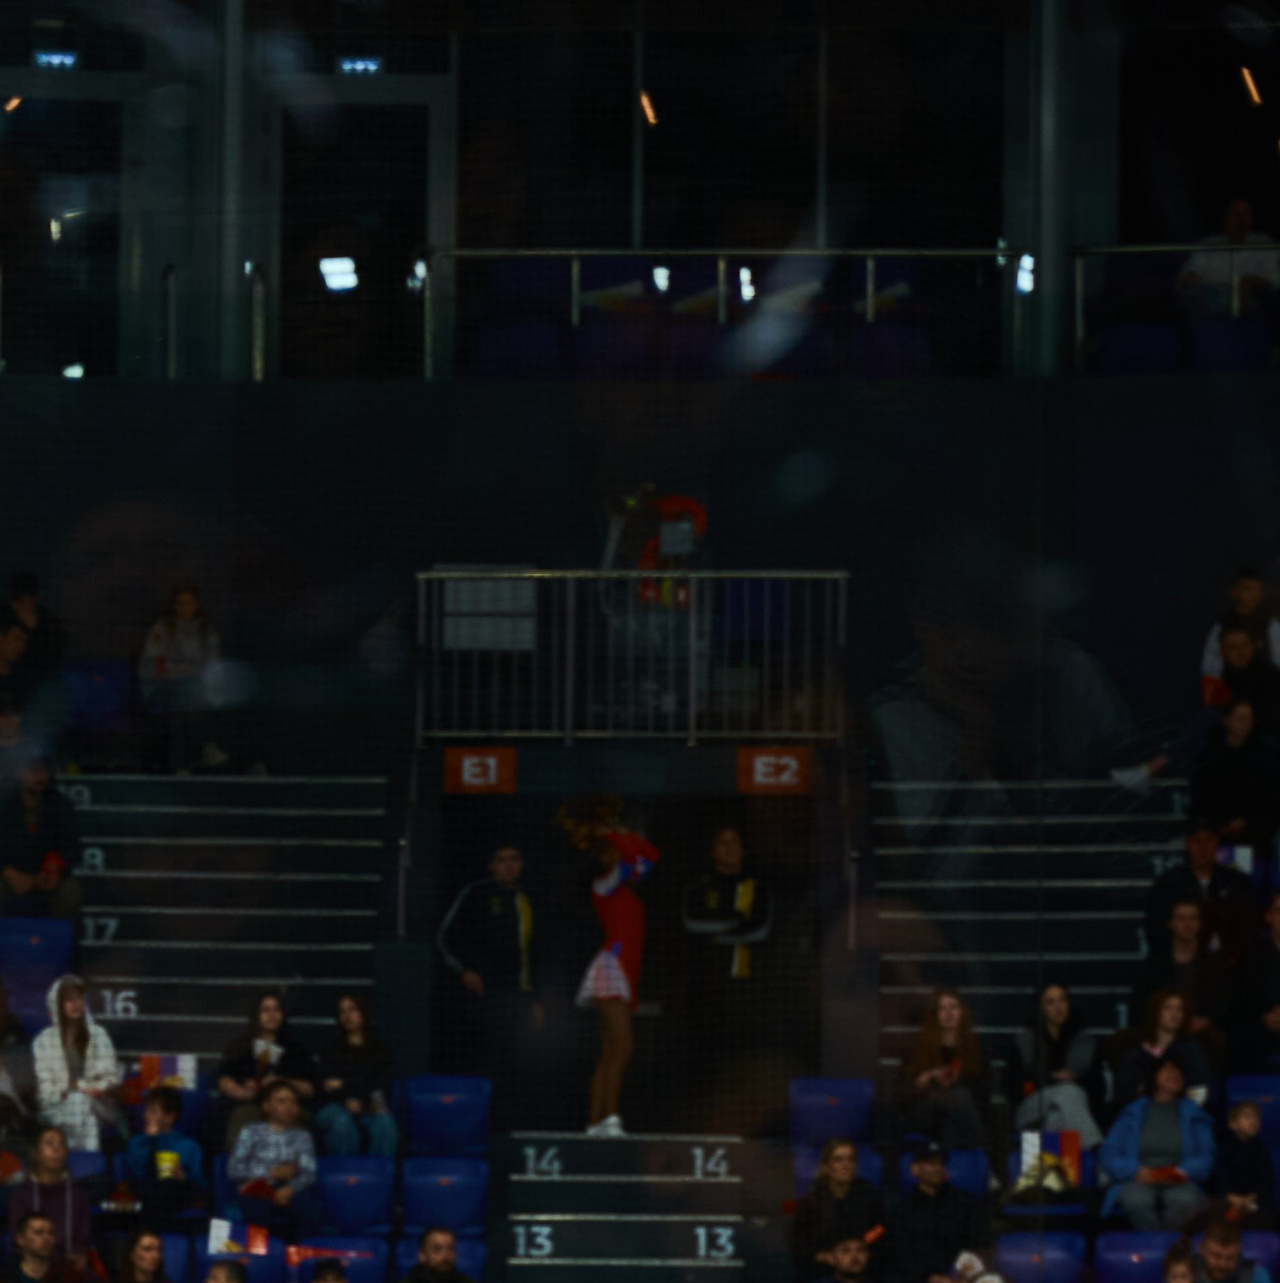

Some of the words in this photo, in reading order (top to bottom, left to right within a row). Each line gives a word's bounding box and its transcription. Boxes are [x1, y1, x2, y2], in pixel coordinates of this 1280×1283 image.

[461, 755, 499, 786] E1
[752, 755, 800, 786] E2
[82, 917, 120, 943] 17
[100, 989, 139, 1018] 16
[522, 1145, 562, 1177] 14
[690, 1146, 730, 1178] 14
[512, 1225, 554, 1258] 13
[694, 1226, 735, 1259] 13
